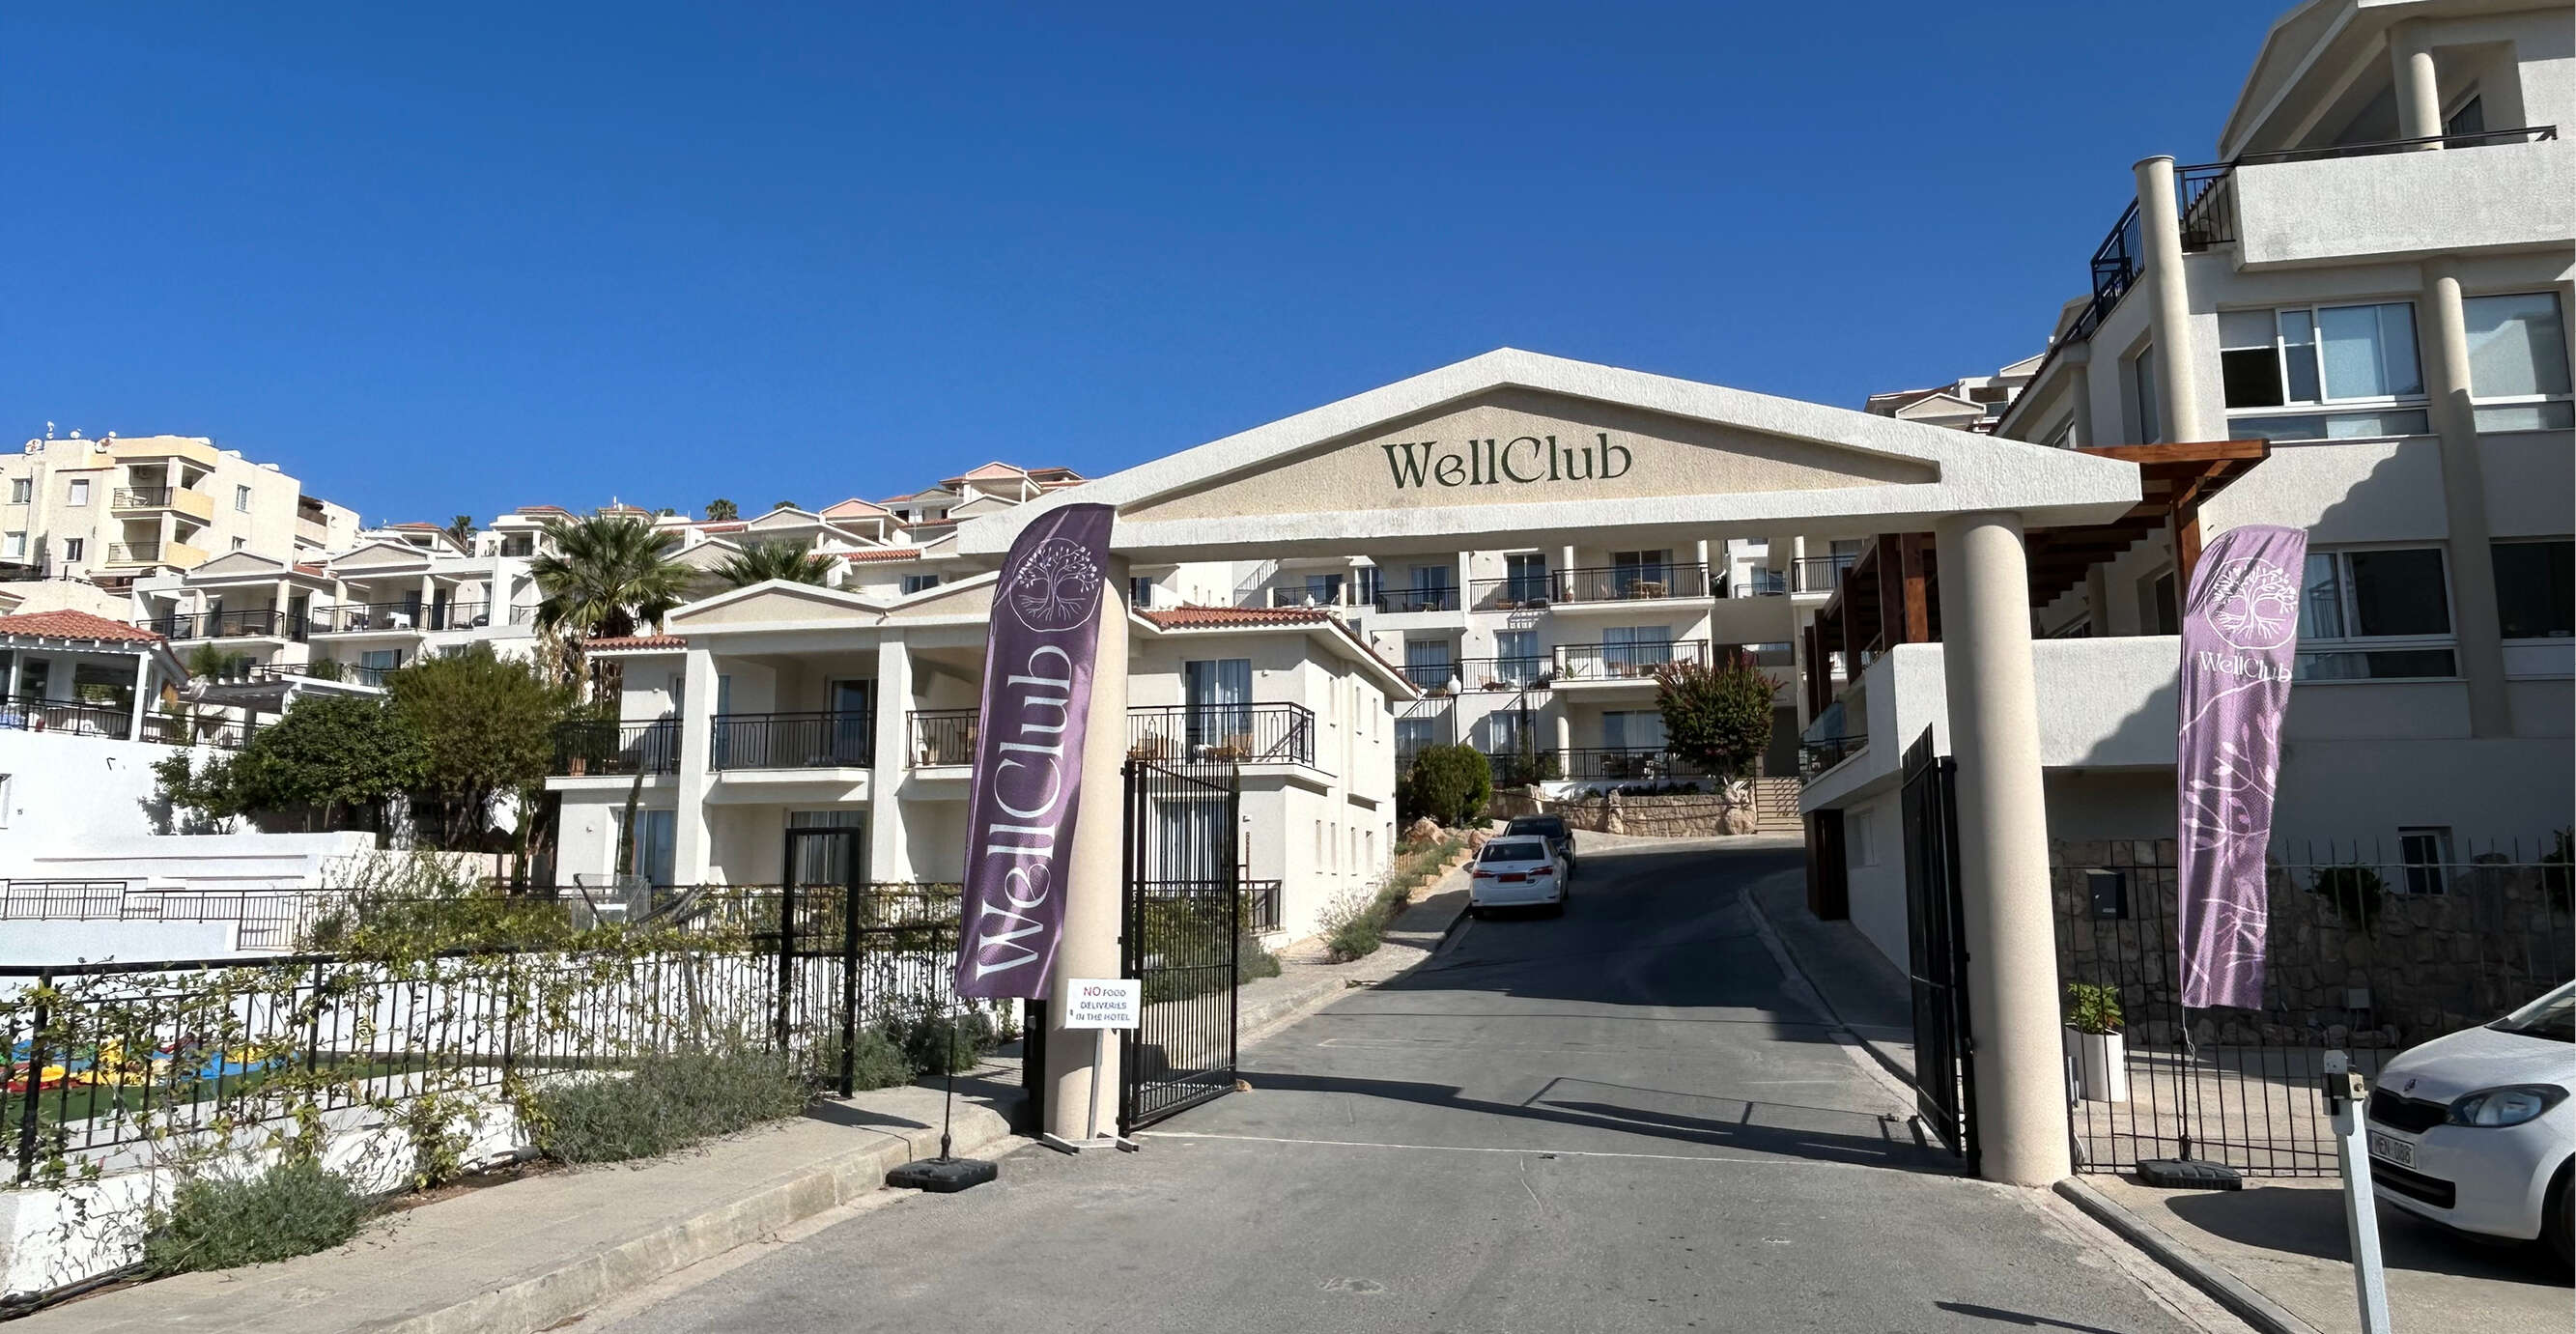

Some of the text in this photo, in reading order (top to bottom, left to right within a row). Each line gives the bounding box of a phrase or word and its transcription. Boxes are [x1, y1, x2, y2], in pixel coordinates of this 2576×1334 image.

[1381, 433, 1632, 489] WellClub
[2199, 651, 2292, 682] WellClub
[976, 645, 1073, 981] WellClub
[1080, 1001, 1127, 1010] DELIVERIES
[1083, 986, 1101, 997] NO
